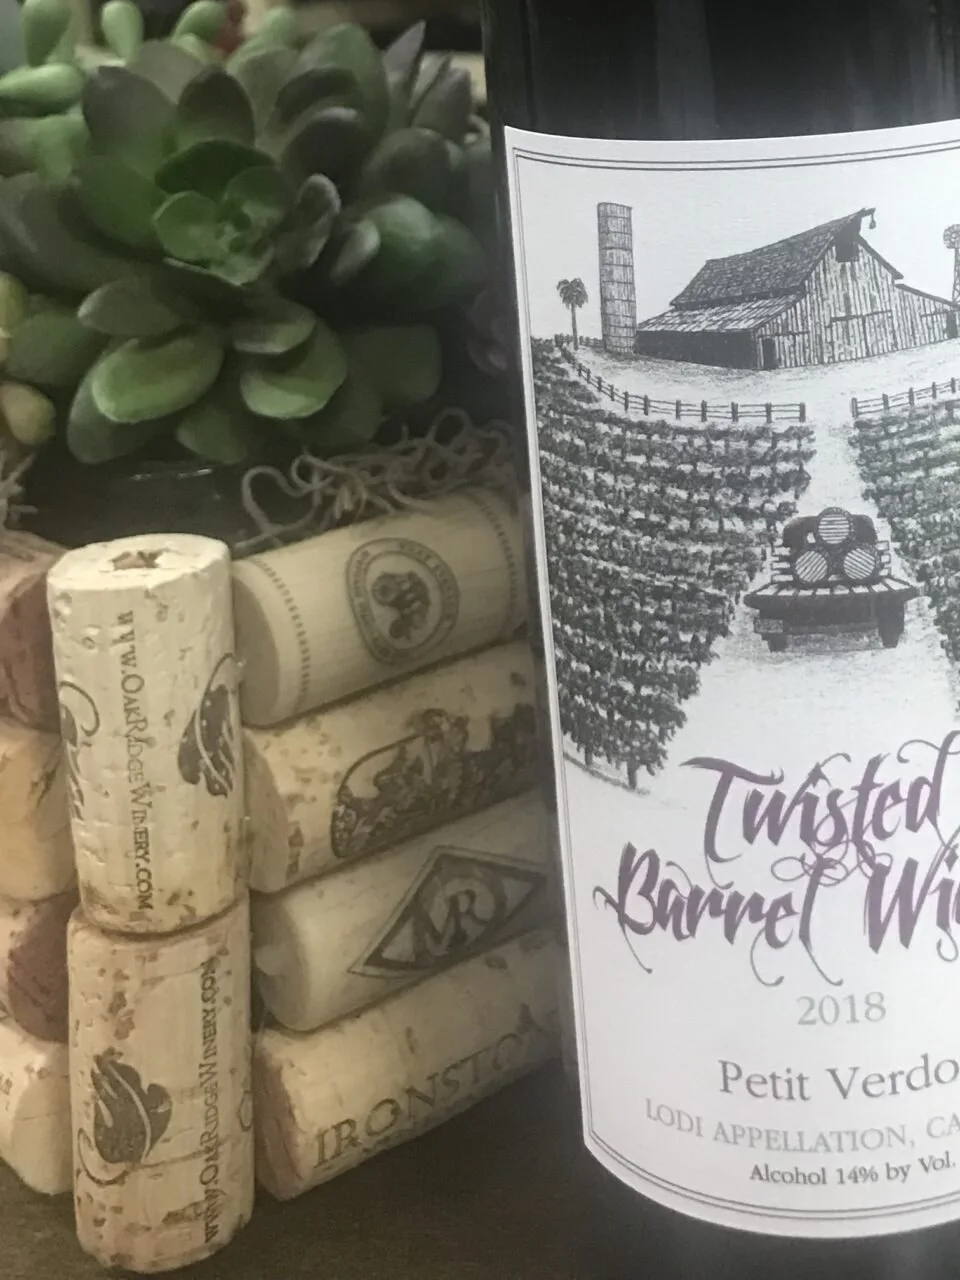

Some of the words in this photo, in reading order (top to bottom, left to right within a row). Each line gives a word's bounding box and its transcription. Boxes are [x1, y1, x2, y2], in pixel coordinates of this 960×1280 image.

[593, 842, 843, 986] Barrel
[795, 991, 887, 1025] 2018
[717, 1058, 811, 1101] Petit
[644, 1097, 706, 1139] LODI
[712, 1119, 916, 1155] APPELLATION,
[749, 1162, 828, 1186] Alcohol
[834, 1164, 879, 1185] 14%
[884, 1159, 912, 1183] by
[917, 1150, 957, 1175] Vol.
